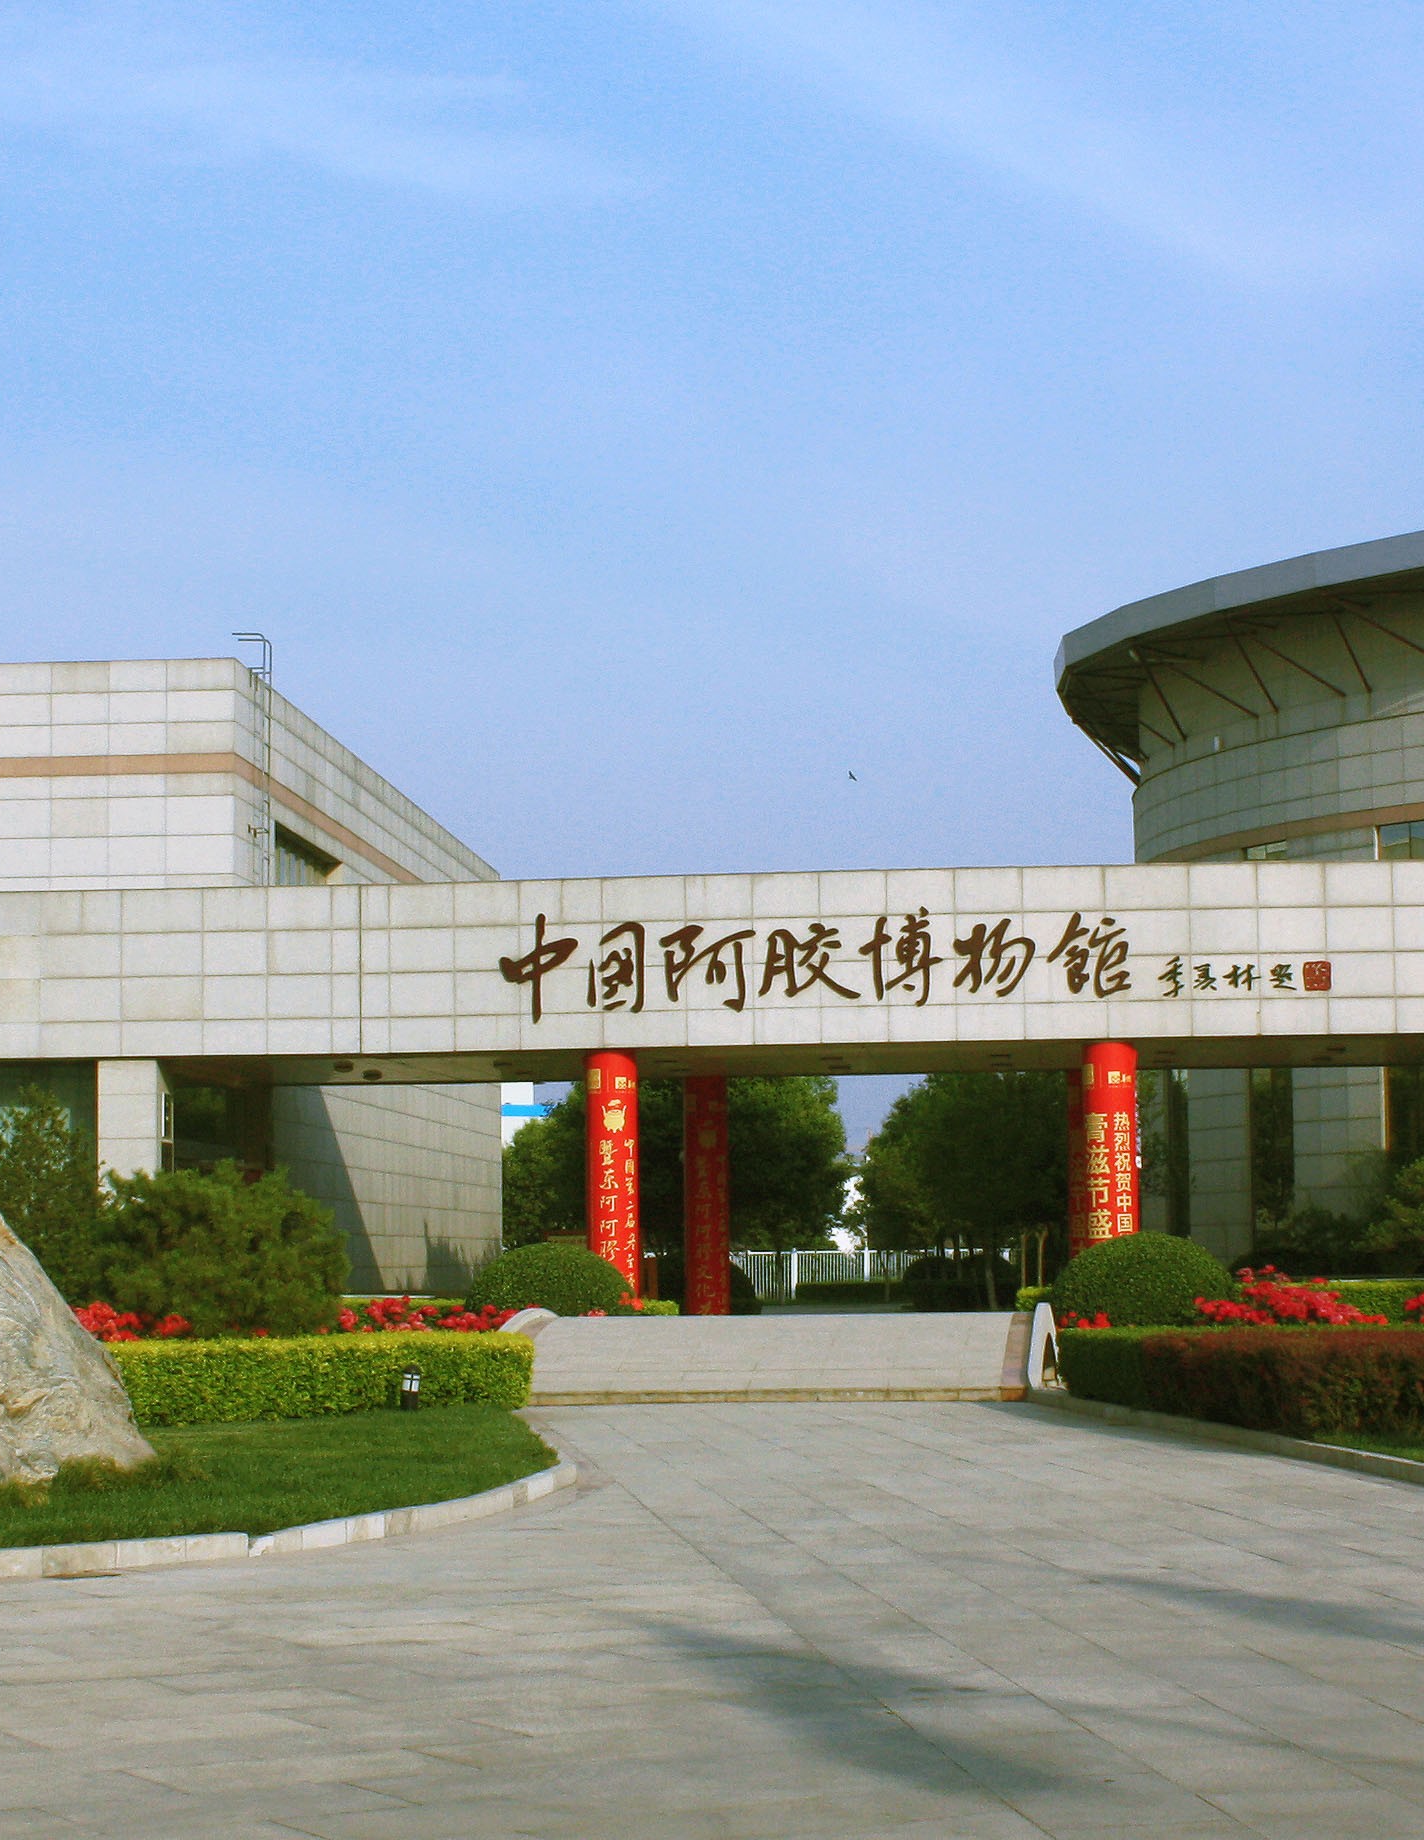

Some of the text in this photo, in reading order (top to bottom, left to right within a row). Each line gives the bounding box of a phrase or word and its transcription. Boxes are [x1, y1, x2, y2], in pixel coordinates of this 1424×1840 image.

[1113, 1111, 1133, 1238] 热烈祝贺中国
